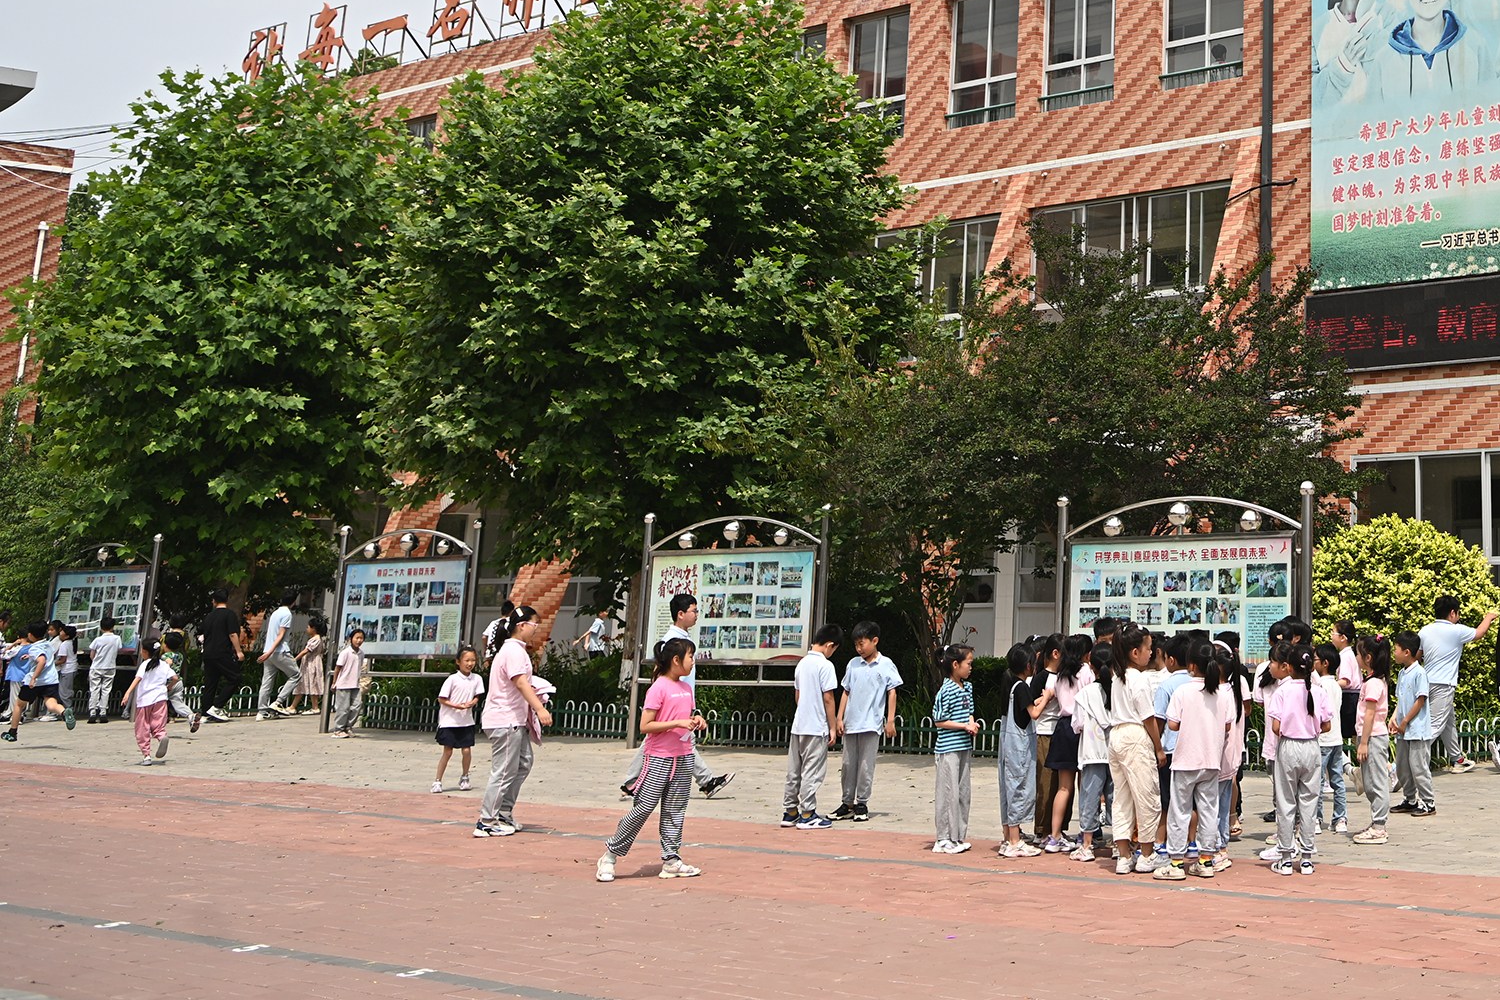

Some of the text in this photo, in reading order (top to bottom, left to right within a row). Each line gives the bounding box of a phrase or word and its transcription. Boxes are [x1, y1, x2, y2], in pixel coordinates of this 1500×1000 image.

[1333, 202, 1441, 232] 国梦时刻准备着。
